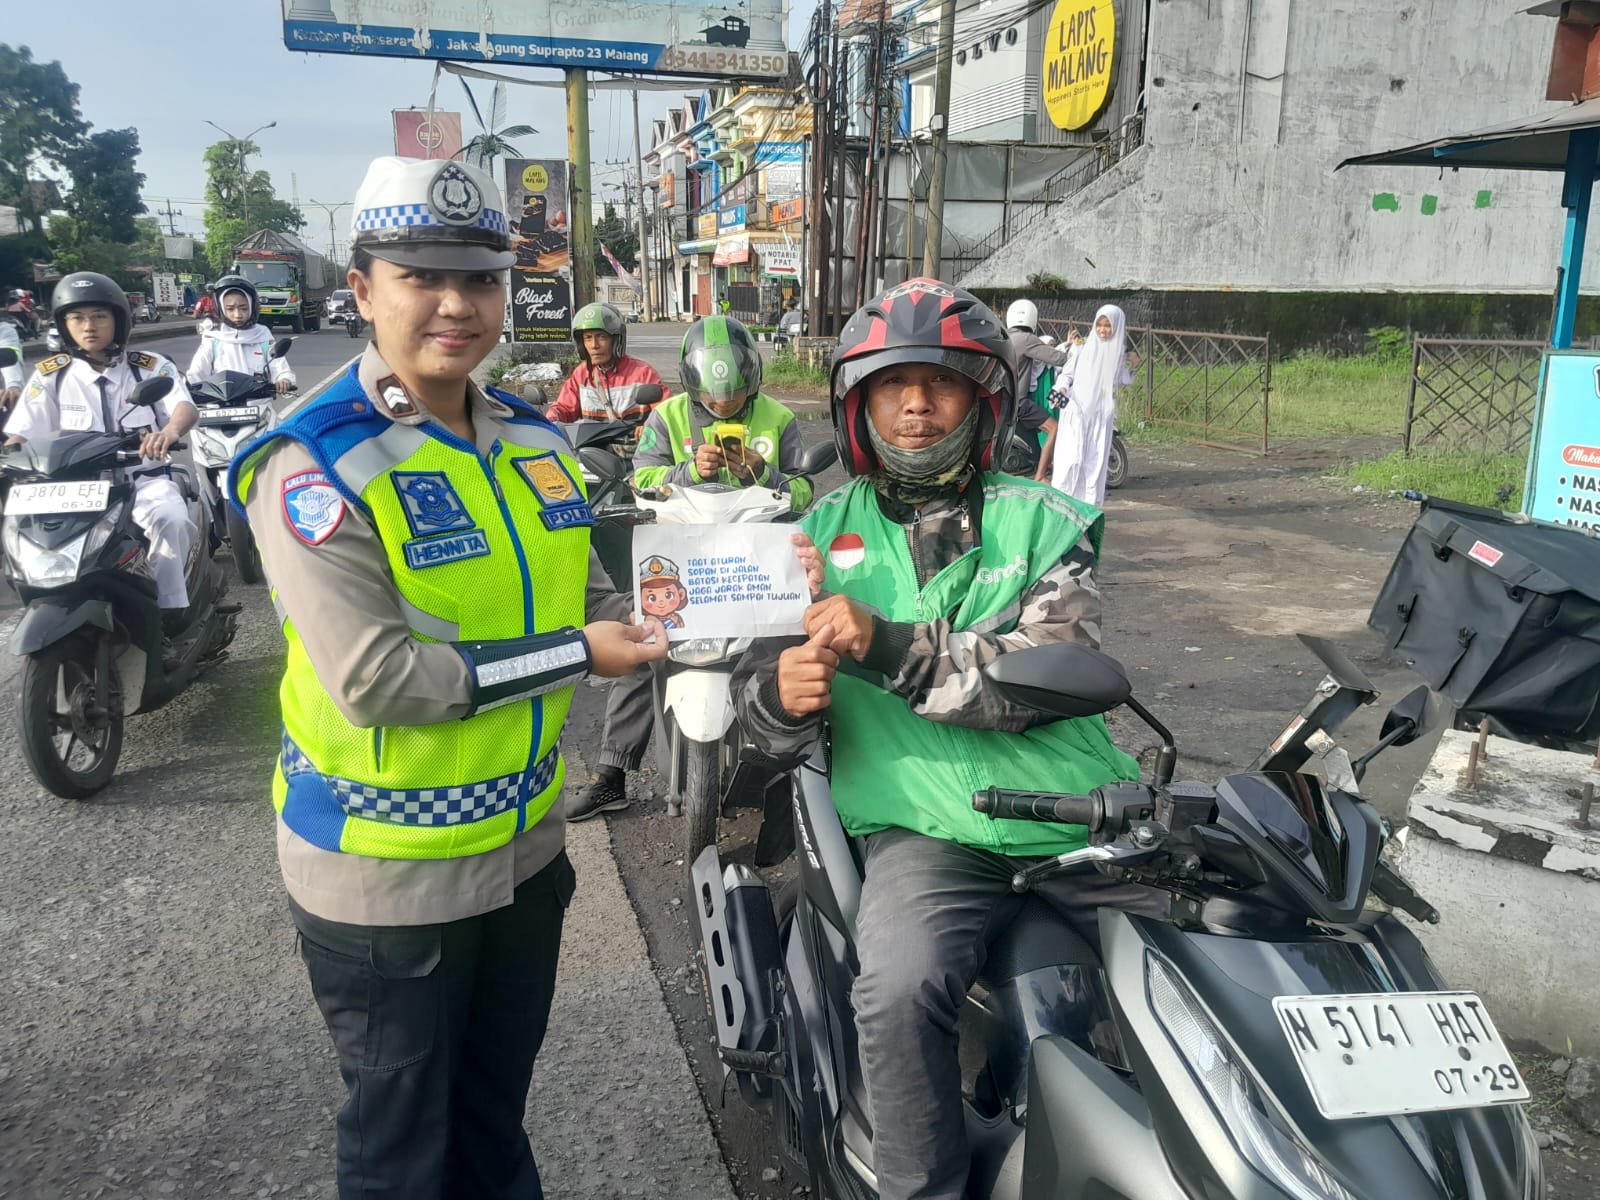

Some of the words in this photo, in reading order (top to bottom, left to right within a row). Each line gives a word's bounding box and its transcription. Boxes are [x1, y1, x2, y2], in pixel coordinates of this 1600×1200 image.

[1059, 6, 1096, 52] LAPIS
[486, 41, 526, 57] Agung
[528, 44, 585, 59] Suprapto
[587, 47, 602, 59] 23
[664, 46, 785, 73] 0341-341350
[1048, 39, 1109, 93] MALANG
[514, 287, 554, 304] Black
[526, 303, 568, 321] Forest
[29, 484, 66, 498] 3870
[78, 483, 105, 497] EFL
[413, 535, 485, 563] HENNITA
[688, 558, 707, 567] TAAT
[711, 556, 746, 566] ATURAN
[976, 554, 1028, 584] Grab
[688, 567, 717, 577] SOPAN
[732, 565, 759, 574] JALAN
[688, 576, 719, 586] BATASI
[722, 574, 770, 584] KECEPATAN
[689, 586, 712, 596] JAGA
[715, 584, 743, 594] JARAK
[747, 583, 772, 592] AMAN
[689, 594, 727, 605] SELAMAT
[731, 593, 764, 602] SAMPAI
[767, 592, 801, 601] TUJUAN
[1284, 1007, 1319, 1052] N
[1323, 1003, 1413, 1049] 5141
[1427, 1001, 1492, 1045] HAT
